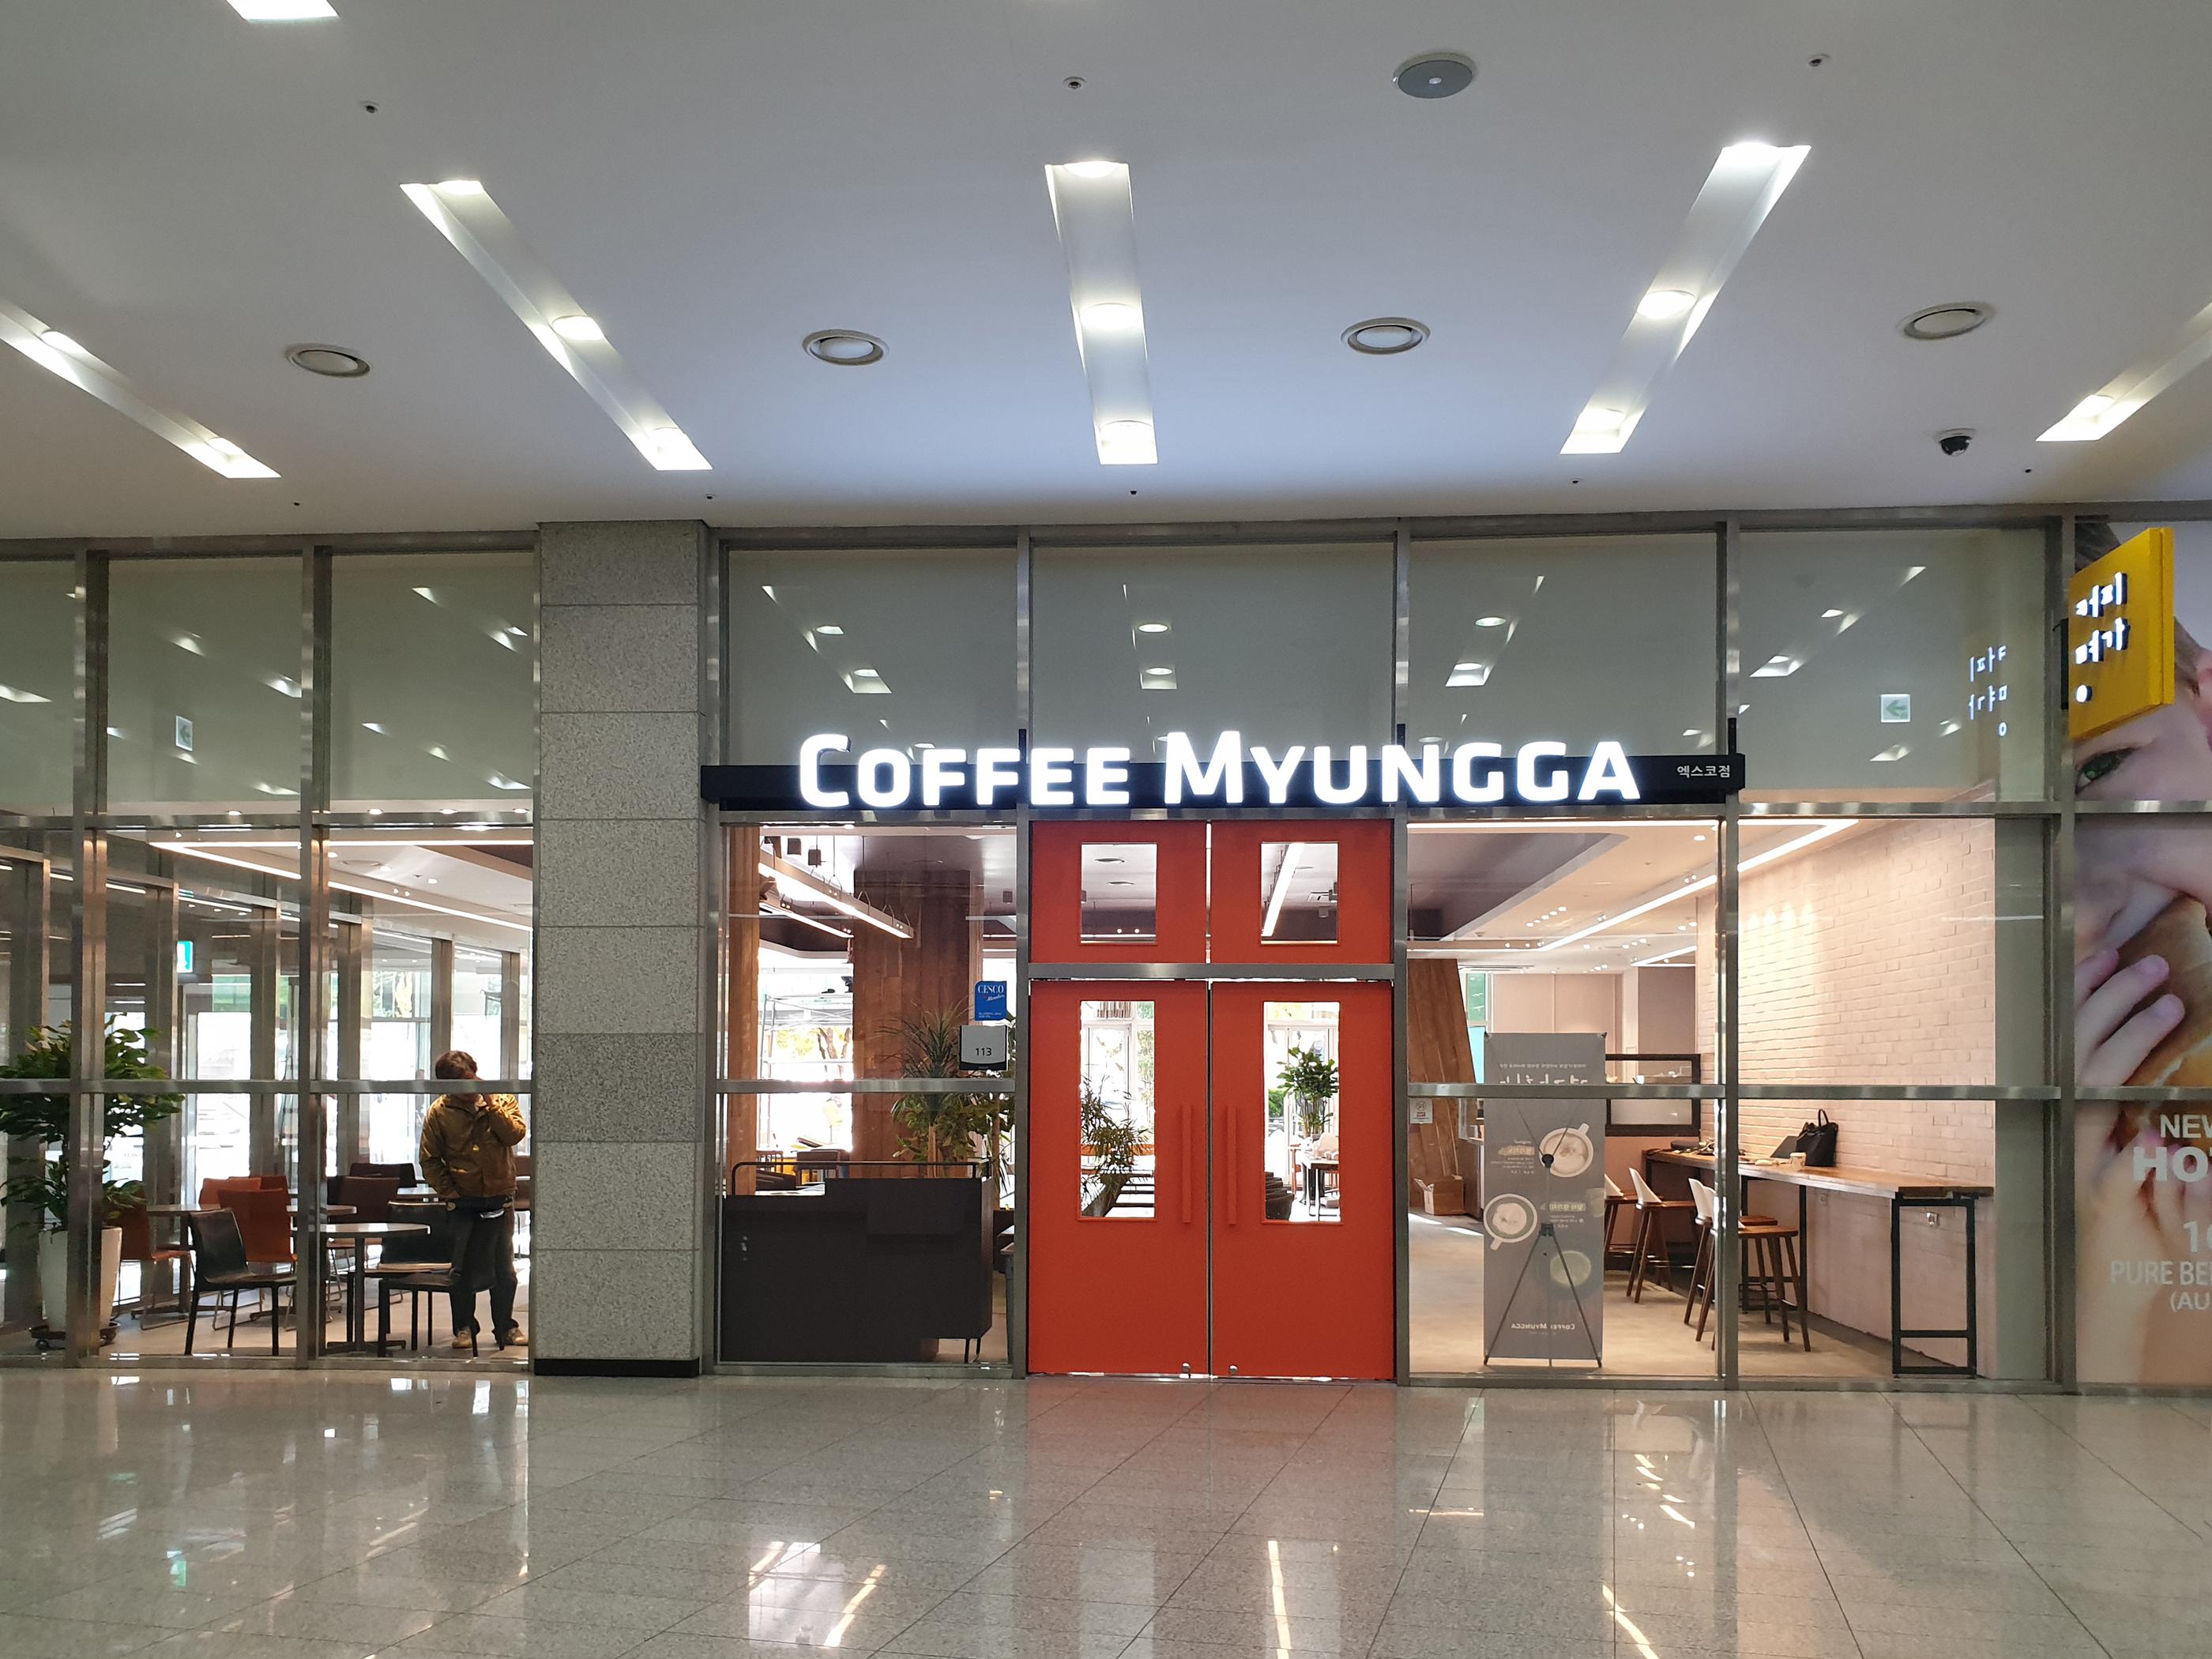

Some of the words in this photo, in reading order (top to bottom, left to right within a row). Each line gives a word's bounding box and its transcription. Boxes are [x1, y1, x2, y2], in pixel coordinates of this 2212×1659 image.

[799, 733, 1130, 807] COFFEE
[1163, 731, 1641, 804] MYUNGGA
[1676, 765, 1730, 779] 엑스코점
[977, 984, 1004, 994] CESCO
[975, 1047, 992, 1056] 113
[2133, 1146, 2212, 1182] HO
[2110, 1260, 2174, 1285] PURE
[2180, 1261, 2212, 1285] BE
